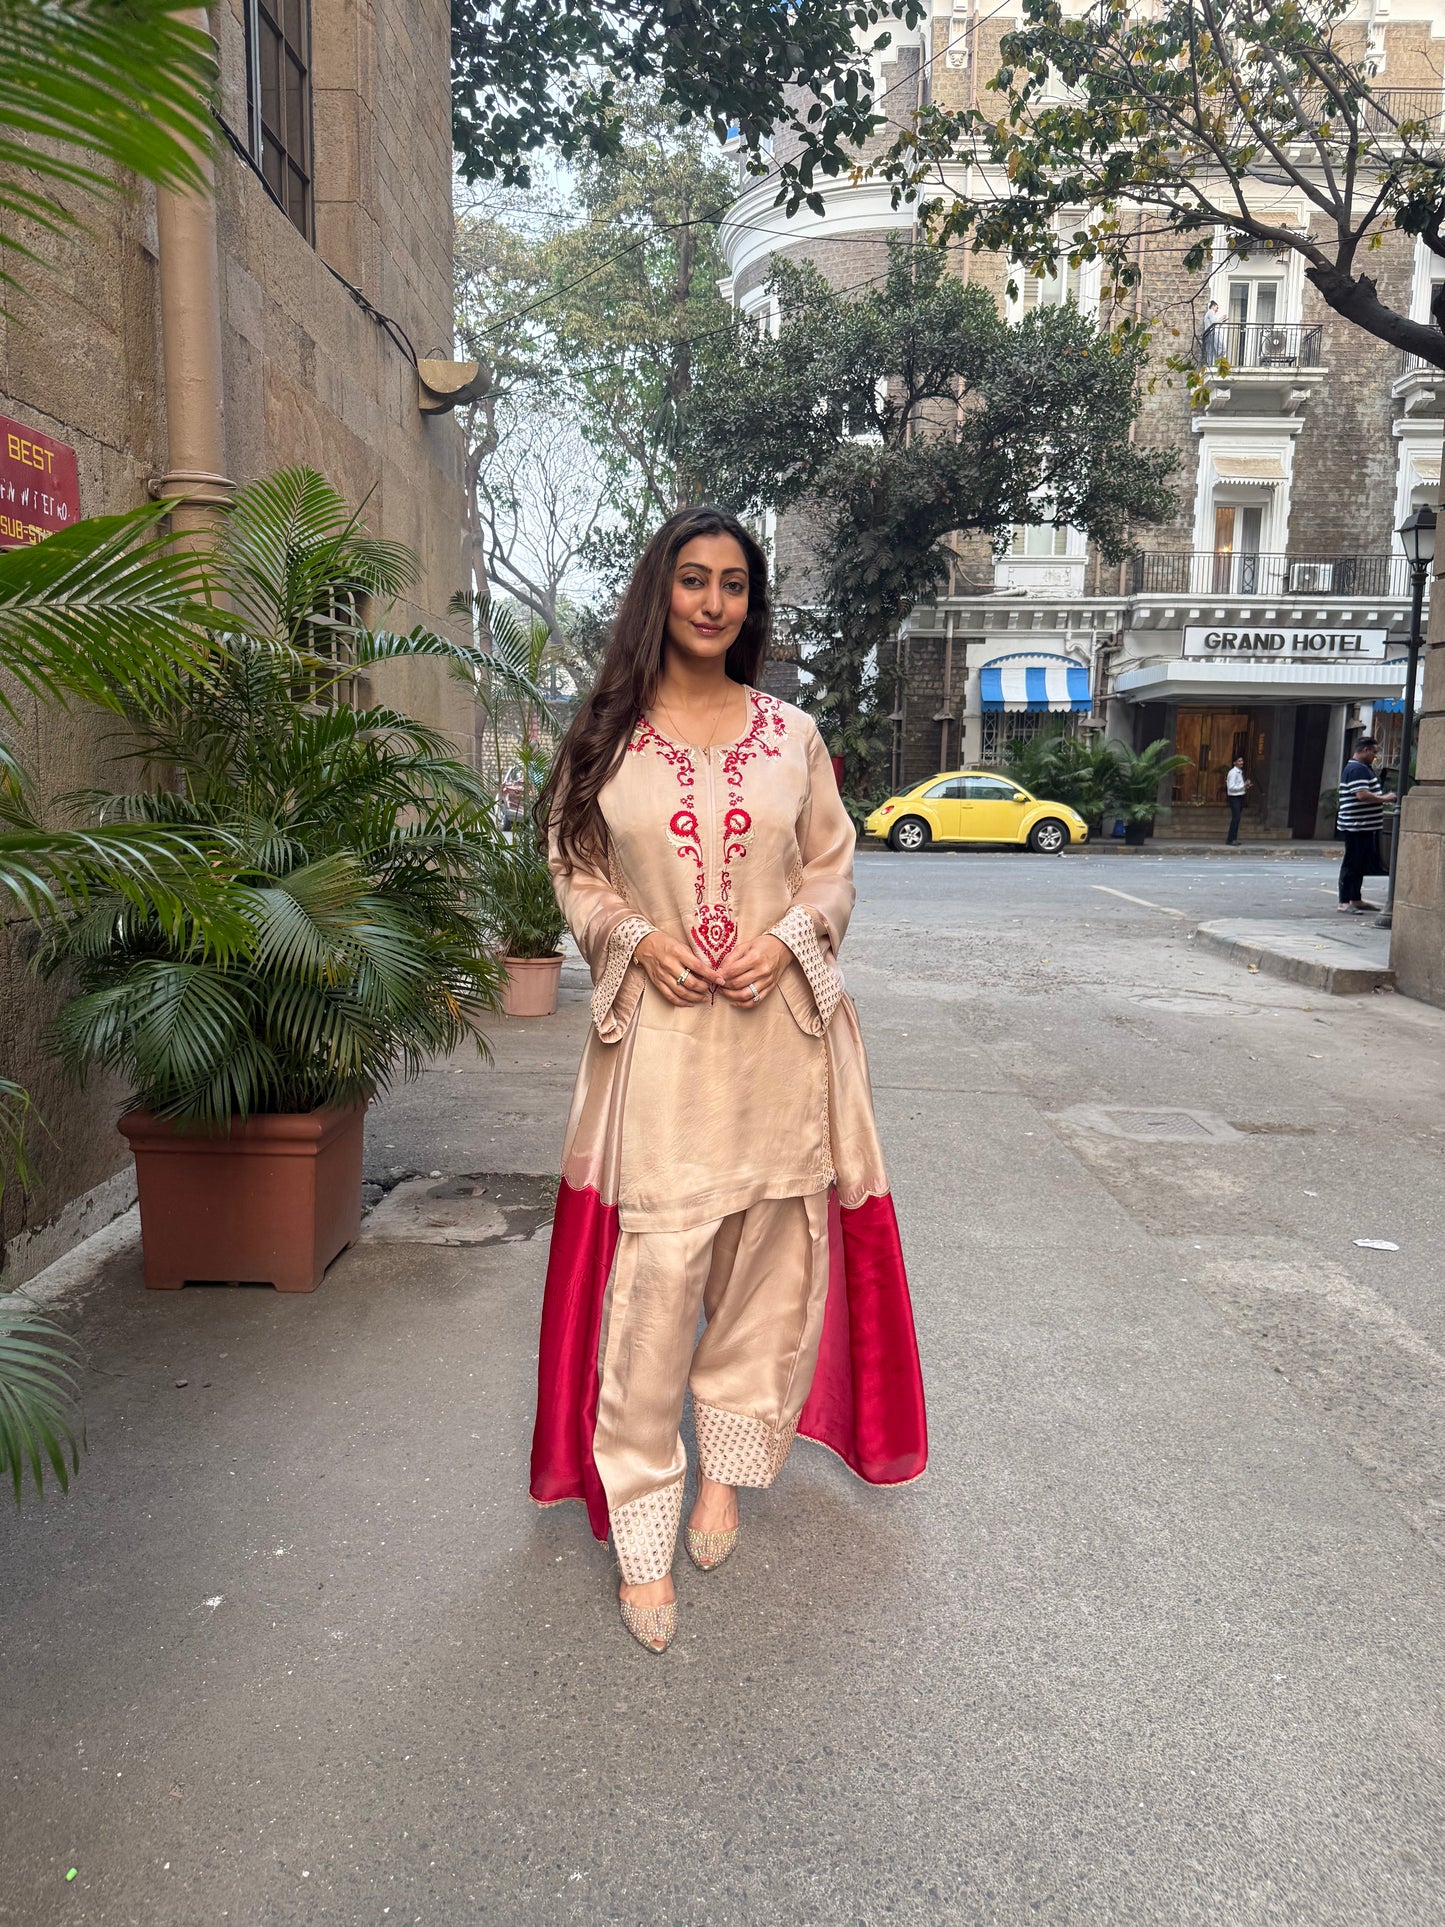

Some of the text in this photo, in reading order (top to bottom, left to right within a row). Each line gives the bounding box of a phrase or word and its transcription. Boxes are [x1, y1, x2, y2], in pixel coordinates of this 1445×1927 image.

[7, 433, 54, 474] BEST
[1204, 632, 1369, 652] GRAND HOTEL
